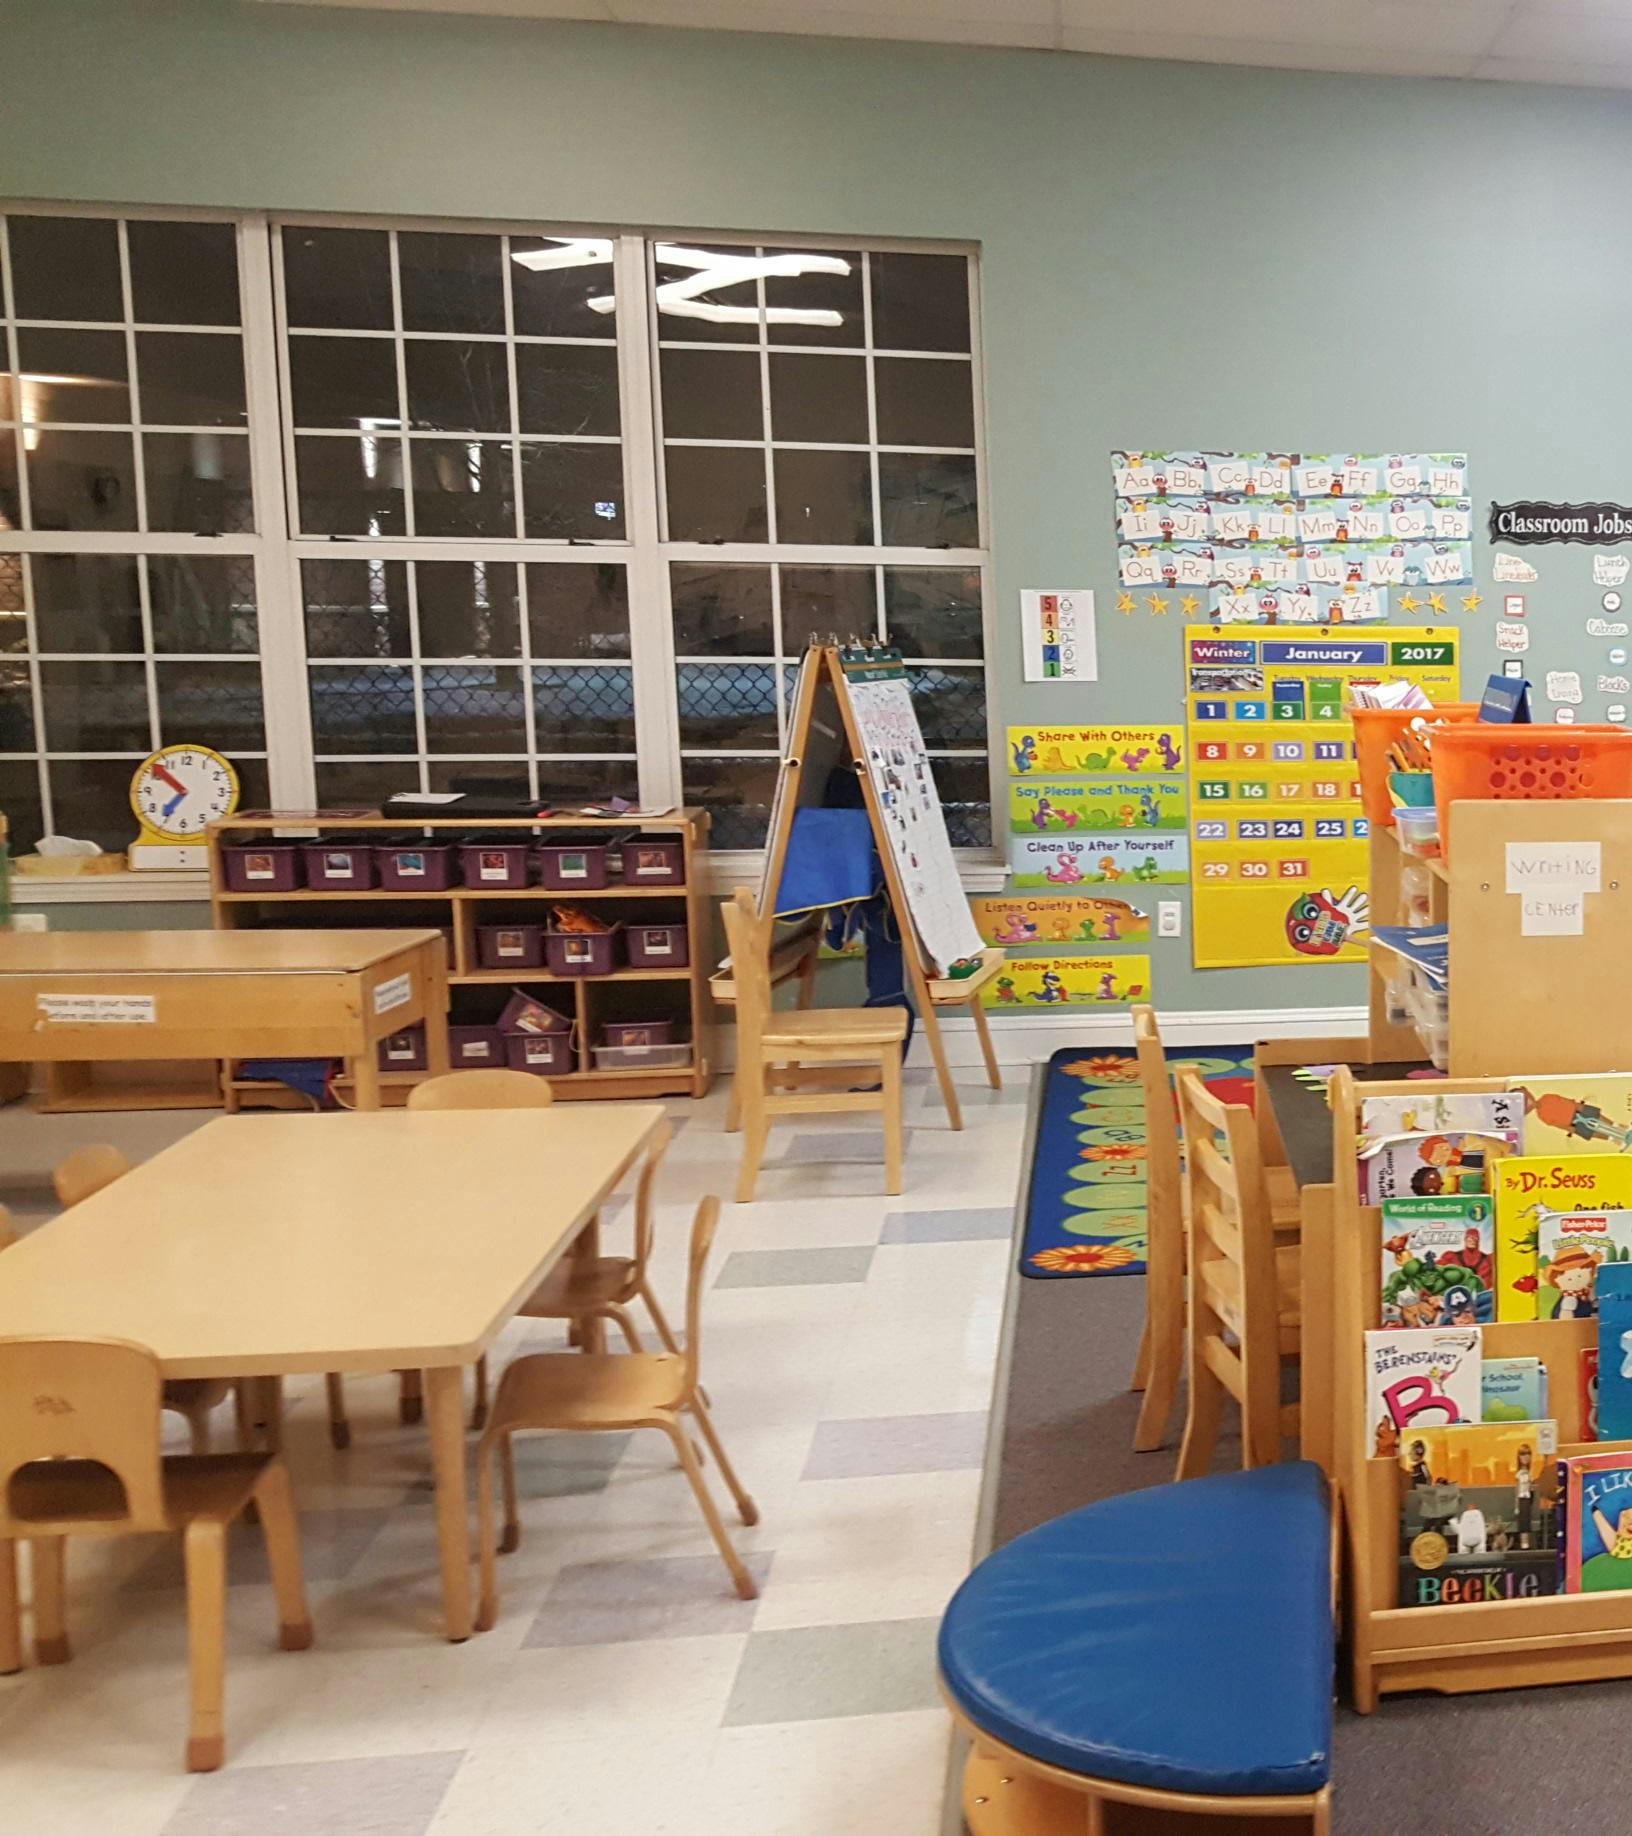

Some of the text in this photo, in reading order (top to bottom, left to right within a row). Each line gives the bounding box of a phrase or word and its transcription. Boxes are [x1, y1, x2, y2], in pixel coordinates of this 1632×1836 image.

[1123, 467, 1458, 491] Aa Bb Cc Dd Ee Ff Gg Hh
[1135, 515, 1463, 537] Ii Jj Kk Ll Mm Nn Oo Pp
[1498, 511, 1589, 533] Classroom
[1126, 560, 1461, 582] Qq Rr Ss Tt Uu Vv Ww
[1044, 596, 1052, 610] 5
[1227, 597, 1371, 615] Xx Yy Zz
[1045, 613, 1053, 626] 4
[1047, 630, 1054, 643] 3
[1048, 646, 1056, 660] 2
[1194, 646, 1446, 664] Winter January 2017
[1049, 662, 1056, 676] 1
[1206, 704, 1333, 718] 1 2 3 4
[1037, 730, 1155, 742] Share With Others
[1205, 745, 1337, 758] 8 9 10 11
[181, 755, 192, 766] 12
[202, 760, 206, 769] 1
[213, 771, 220, 781] 2
[144, 786, 152, 796] 9
[217, 787, 225, 797] 3
[1015, 784, 1179, 798] Say Please and Thank You
[1203, 783, 1361, 797] 15 16 17 18 1
[149, 803, 156, 813] 8
[210, 803, 218, 811] 4
[179, 818, 187, 829] 6
[199, 813, 206, 824] 5
[1198, 821, 1369, 837] 22 23 24 25 2
[1026, 840, 1175, 854] Clean Up After Yourself
[1203, 861, 1304, 876] 29 30 31
[984, 901, 1089, 914] Listen Quietly to
[1011, 959, 1113, 972] Follow Directions
[1387, 1178, 1395, 1190] We
[1520, 1172, 1548, 1193] Dr.
[1551, 1167, 1596, 1188] Seuss
[1389, 1204, 1416, 1213] World
[1417, 1203, 1427, 1212] of
[1376, 1345, 1398, 1358] THE
[1489, 1373, 1525, 1383] School
[1381, 1375, 1459, 1435] B
[1584, 1485, 1601, 1506] I
